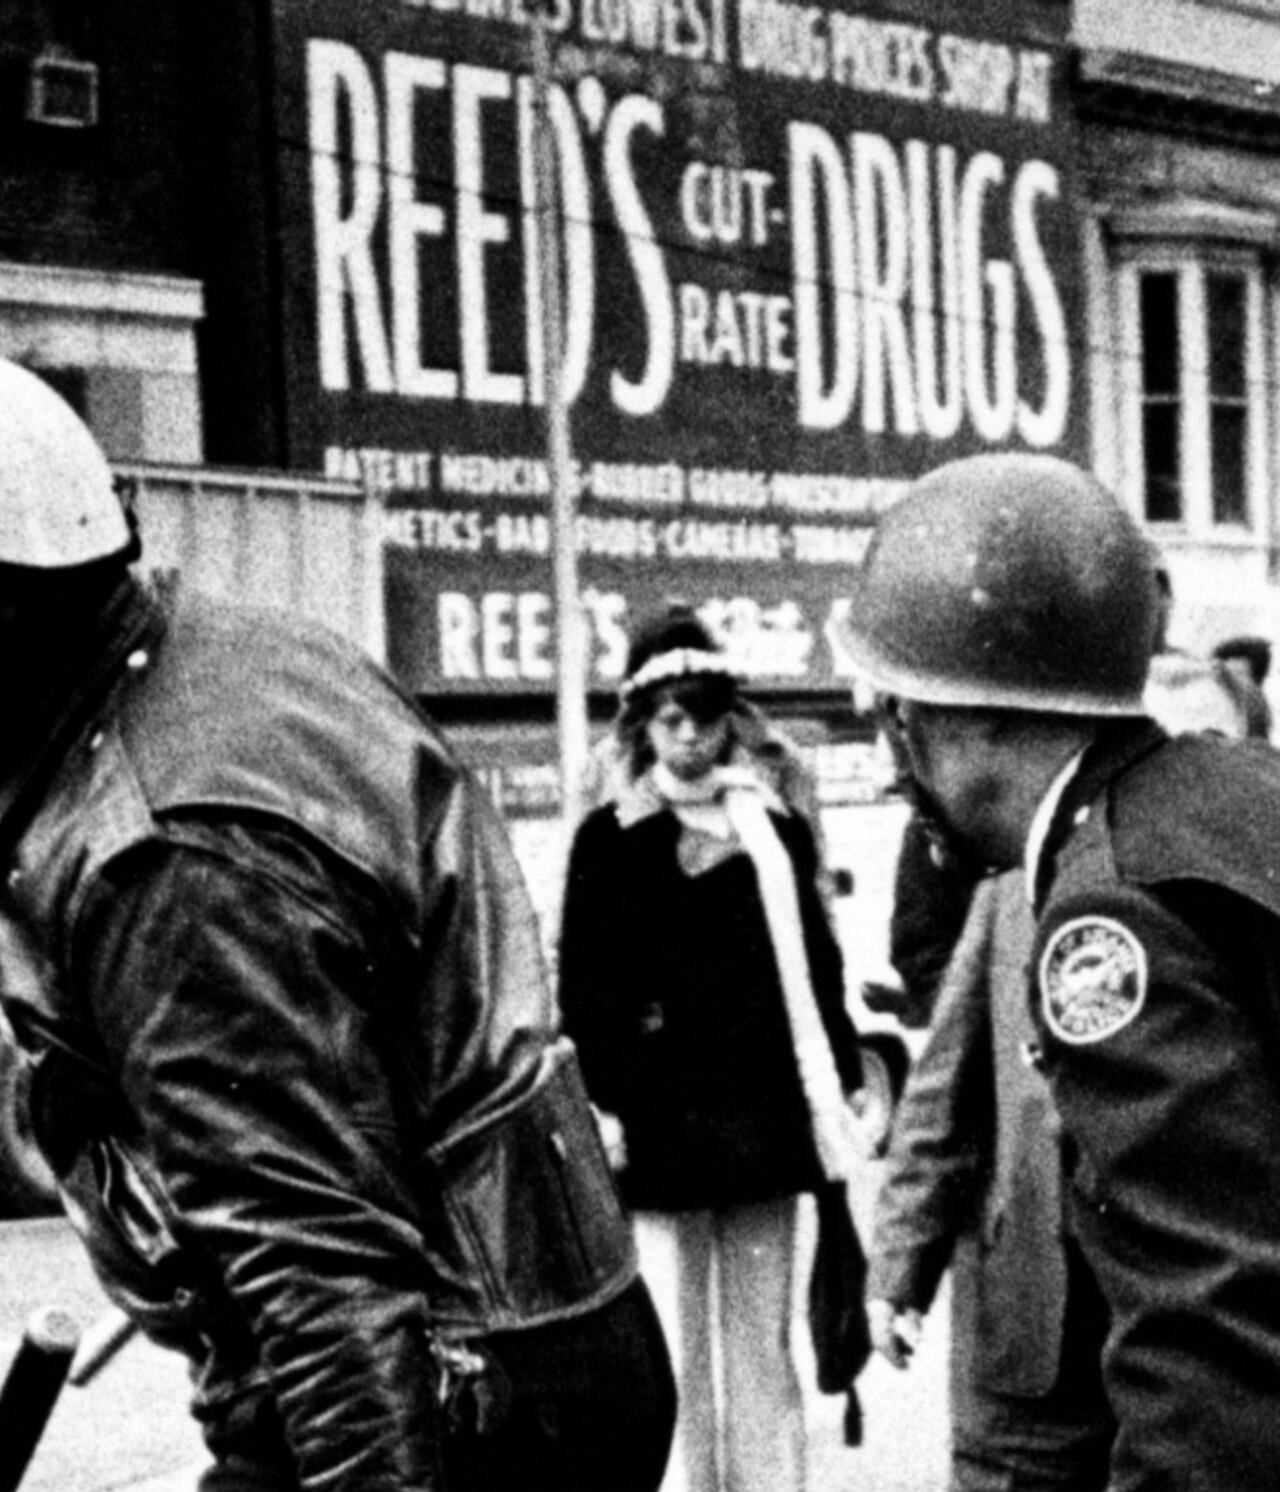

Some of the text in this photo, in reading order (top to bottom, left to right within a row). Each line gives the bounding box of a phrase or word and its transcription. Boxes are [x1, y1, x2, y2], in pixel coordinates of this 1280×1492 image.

[738, 0, 826, 83] DRUG
[828, 9, 934, 101] PRICES
[937, 33, 1015, 117] SHOP
[306, 38, 674, 415] REED'S
[679, 283, 796, 373] RATE
[787, 119, 1071, 447] DRUGS
